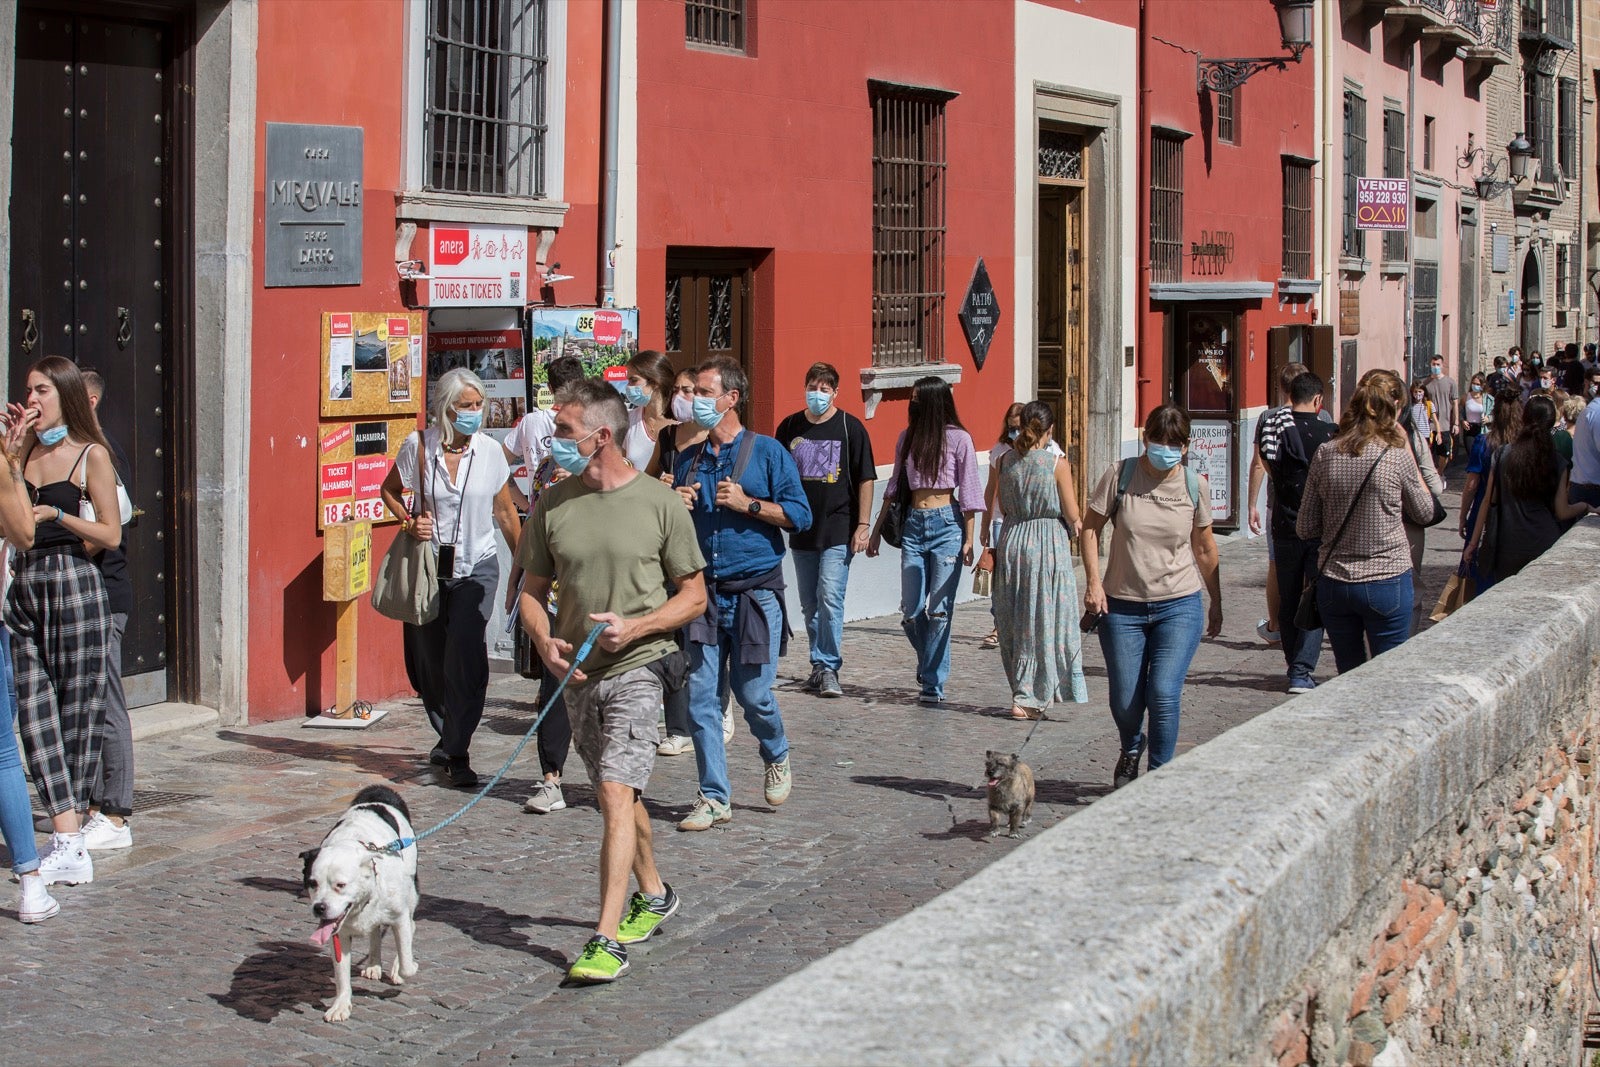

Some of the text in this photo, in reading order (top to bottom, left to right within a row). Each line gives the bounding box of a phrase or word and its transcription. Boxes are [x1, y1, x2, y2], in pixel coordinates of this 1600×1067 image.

[1359, 180, 1407, 191] VENDE
[272, 180, 360, 212] MIRAVALLE
[1359, 191, 1407, 204] 958 228 930
[1358, 205, 1405, 223] OASIS
[439, 240, 464, 254] anera
[300, 248, 334, 265] DARRO
[1191, 241, 1226, 276] PATIO
[434, 283, 502, 299] TOURS & TICKETS
[972, 292, 992, 306] PATIO
[441, 336, 506, 345] TOURIST INFORMATION
[355, 432, 386, 442] ALHAMBRA
[1190, 428, 1232, 438] WORKSHOP
[1192, 438, 1229, 456] Perfume
[328, 466, 348, 477] TICKET
[357, 462, 369, 470] Visita
[322, 480, 352, 491] ALHAMBRA
[1210, 489, 1227, 500] LER
[325, 505, 338, 523] 18
[356, 501, 383, 518] 35 €
